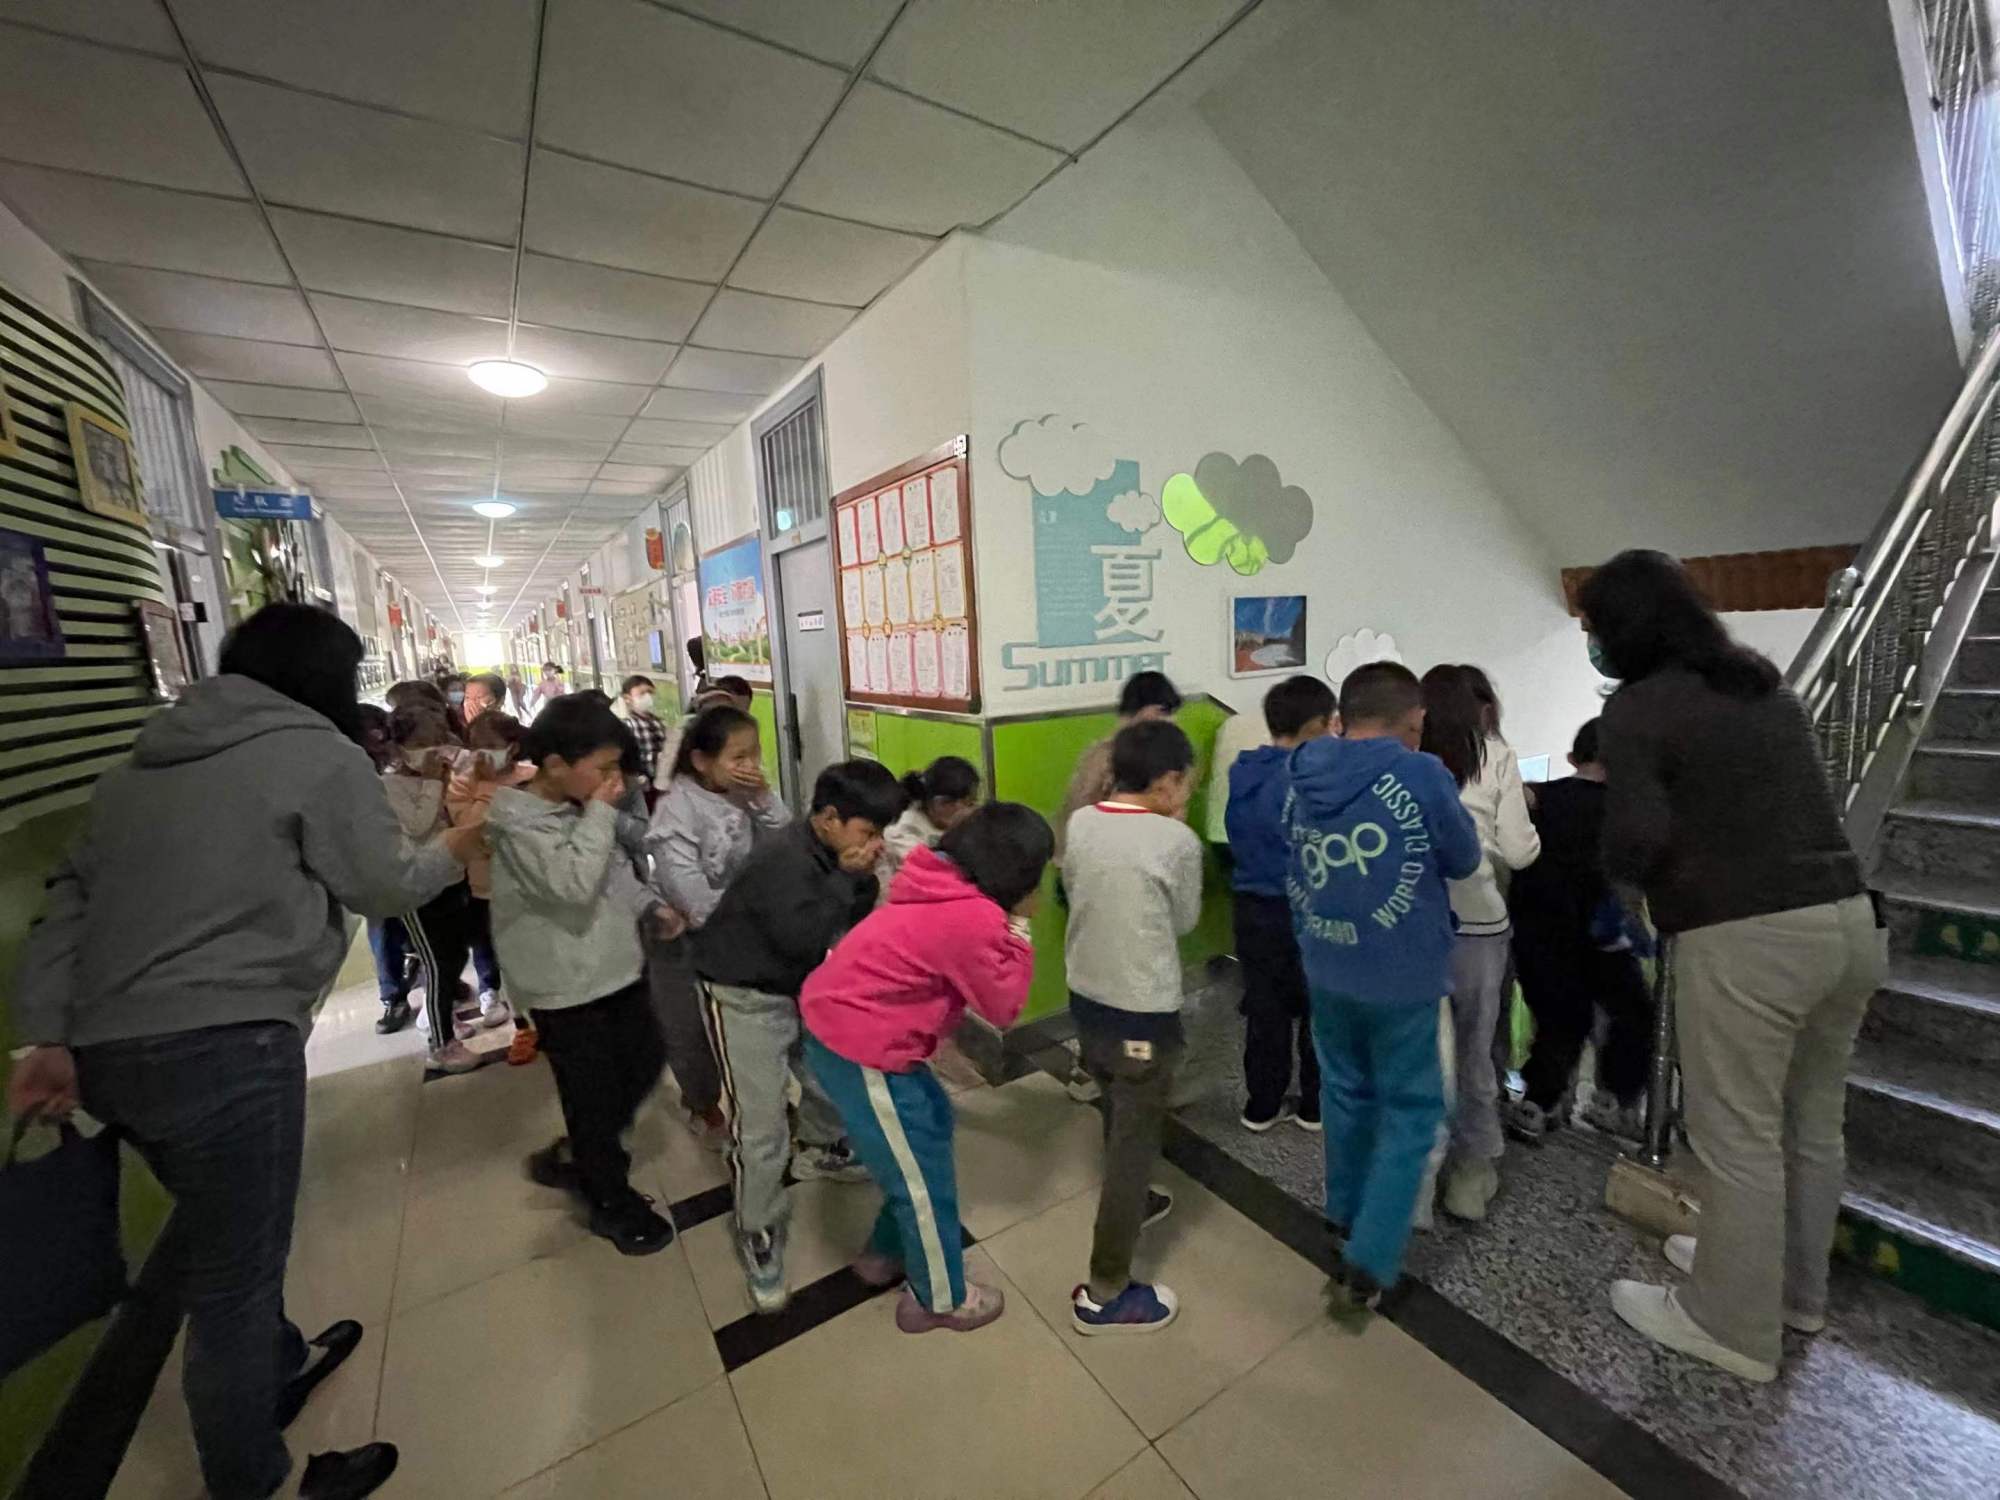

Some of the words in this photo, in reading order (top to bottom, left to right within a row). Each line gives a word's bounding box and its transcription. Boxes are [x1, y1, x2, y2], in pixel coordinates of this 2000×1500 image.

[1090, 544, 1164, 642] 夏
[1372, 773, 1431, 854] CLASSIC
[1371, 861, 1425, 930] WORLD
